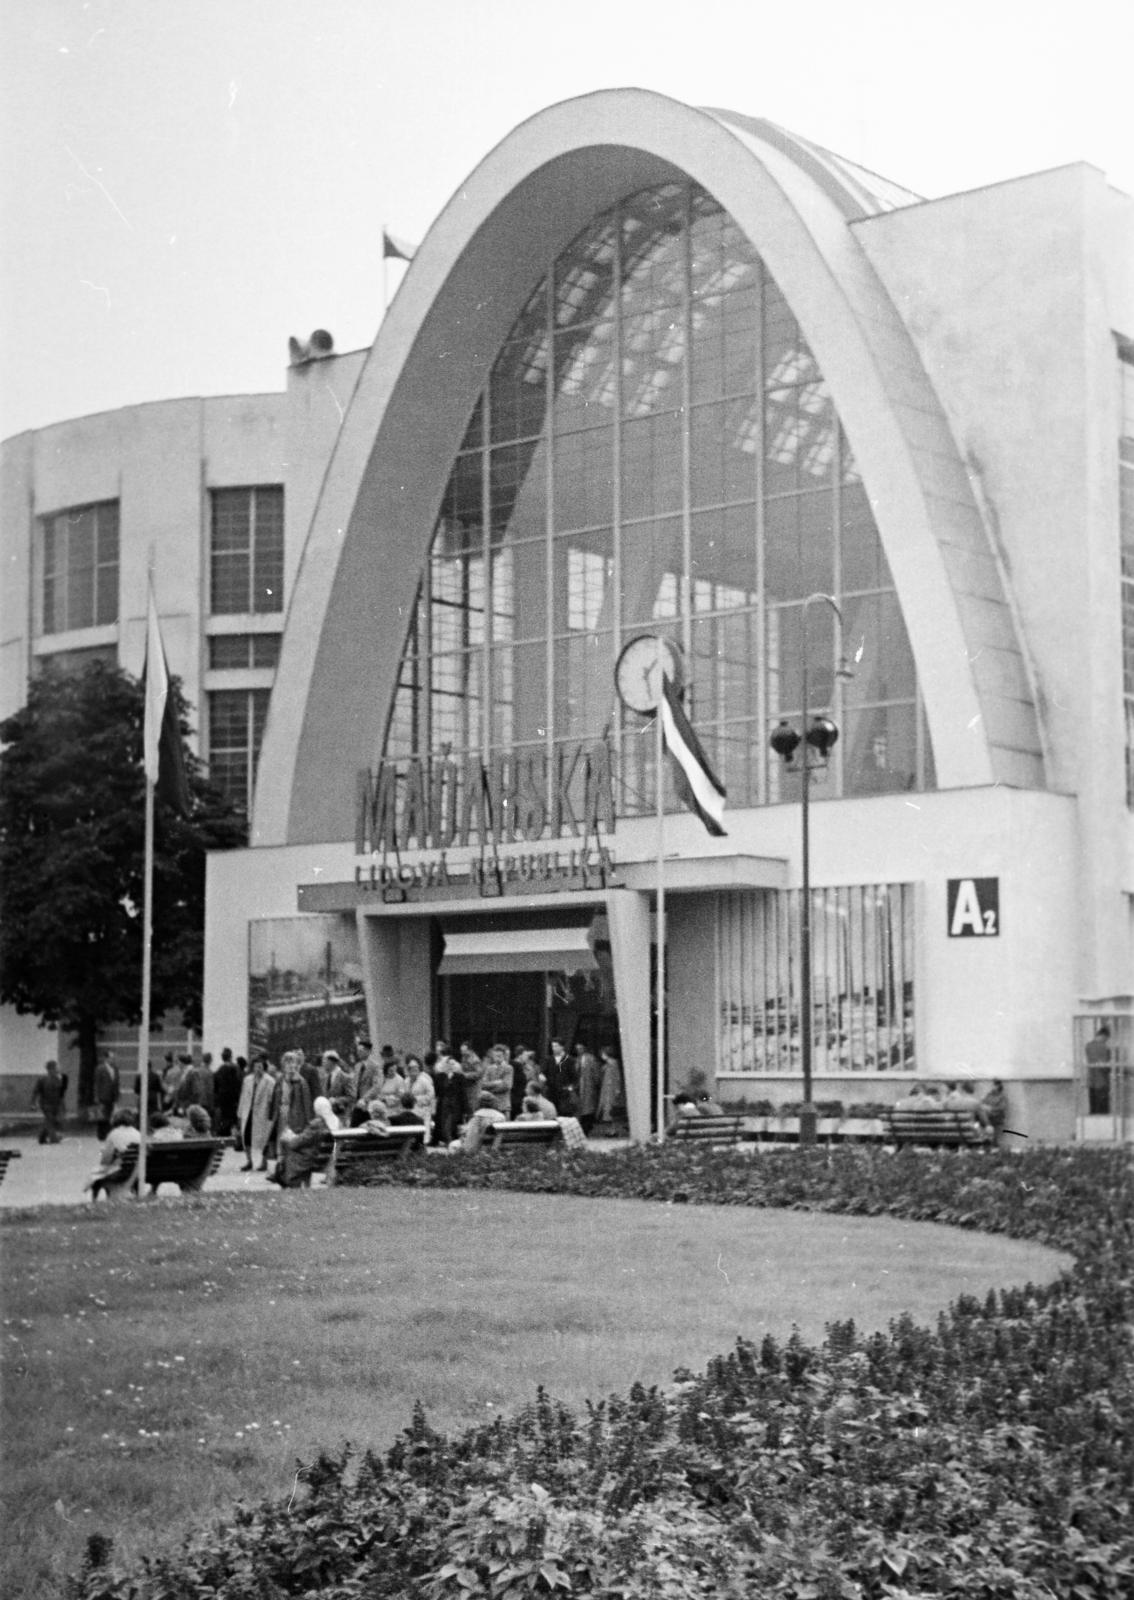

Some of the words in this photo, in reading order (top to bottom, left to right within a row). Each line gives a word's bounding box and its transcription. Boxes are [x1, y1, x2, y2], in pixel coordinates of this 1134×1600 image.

[355, 851, 451, 891] LIDOVÁ
[471, 846, 616, 884] REPUBLIKA
[951, 879, 997, 935] A2
